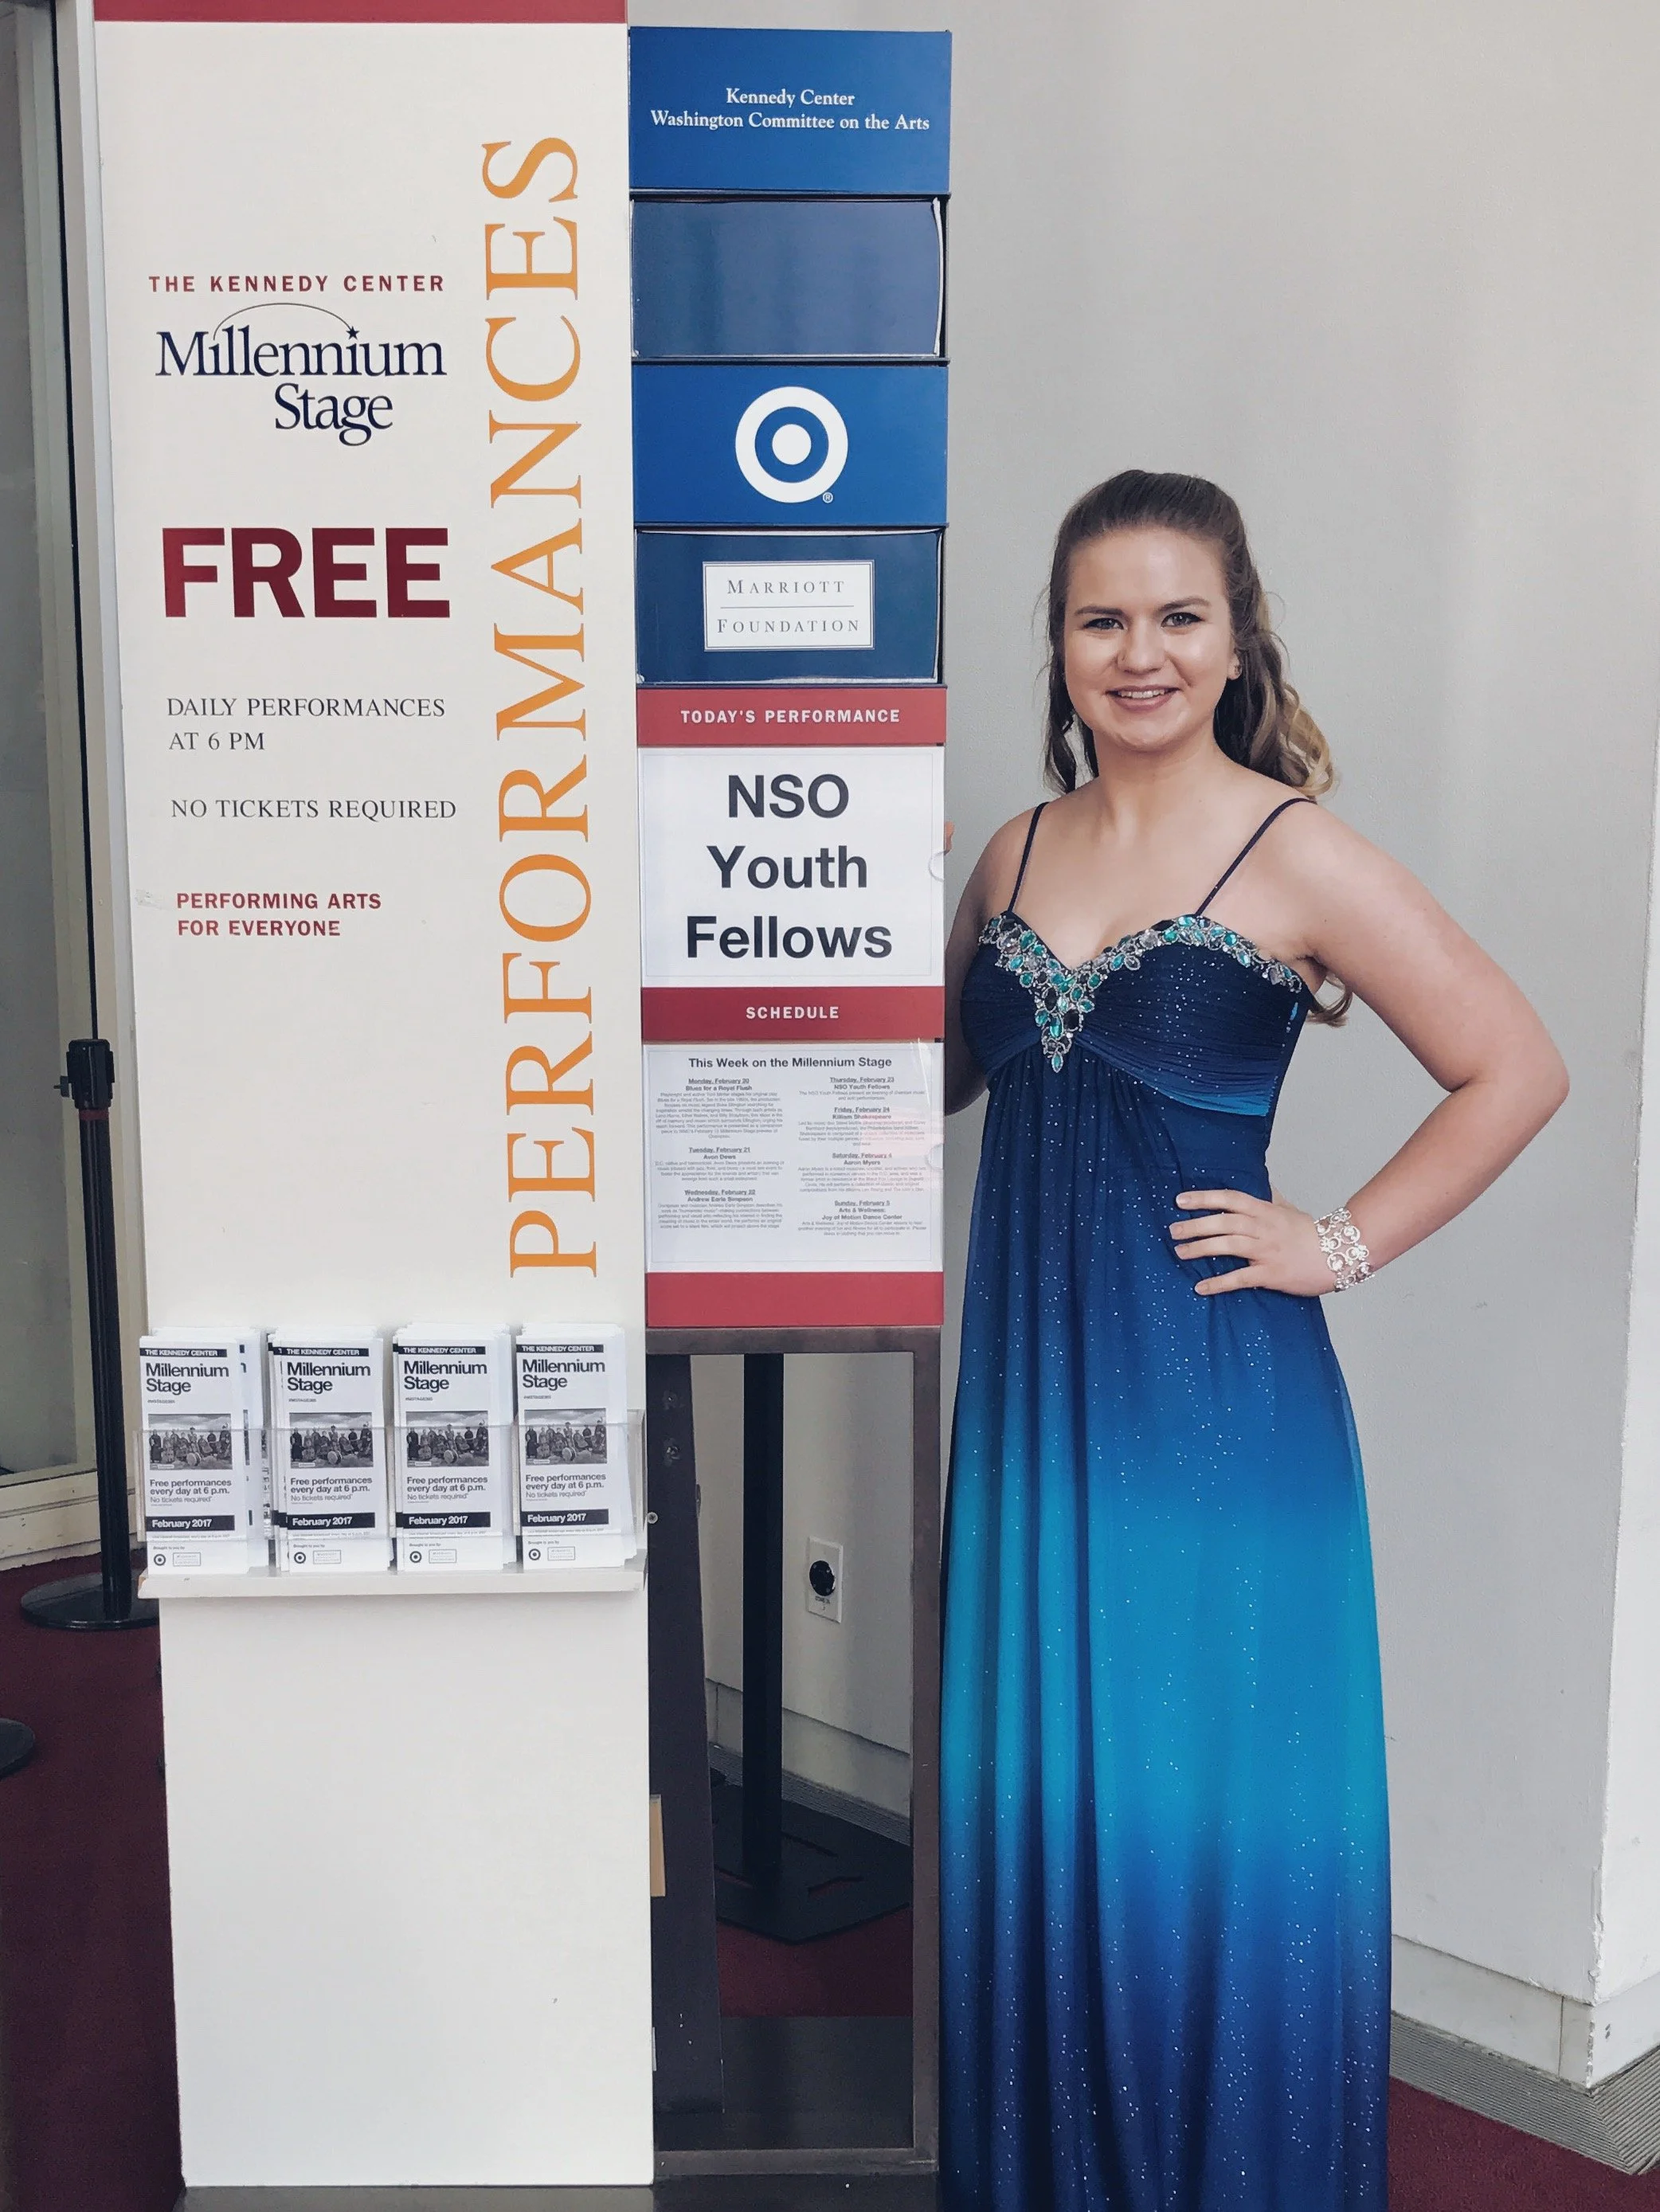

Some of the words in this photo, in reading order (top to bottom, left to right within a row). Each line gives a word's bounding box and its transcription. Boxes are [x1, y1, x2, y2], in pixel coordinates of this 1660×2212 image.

[726, 87, 797, 108] Kennedy
[800, 88, 855, 106] Center
[650, 109, 744, 131] Washington
[748, 112, 836, 129] Committee
[840, 118, 859, 129] on
[864, 112, 890, 130] the
[894, 113, 930, 131] Arts
[148, 276, 195, 292] THE
[210, 275, 328, 292] KENNEDY
[343, 275, 444, 292] CENTER
[155, 323, 448, 377] Millennium
[274, 382, 393, 447] Stage
[162, 527, 451, 618] FREE
[727, 579, 844, 594] MARRIOTT
[717, 618, 859, 633] FOUNDATION
[167, 698, 237, 716] DAILY
[247, 698, 445, 717] PERFORMANCES
[481, 136, 598, 1277] PERFORMANCES
[680, 710, 756, 723] TODAY'S
[765, 709, 900, 723] PERFORMANCE
[169, 732, 199, 750] AT
[208, 733, 220, 750] 6
[229, 732, 264, 750] PM
[728, 773, 849, 819] NSO
[171, 799, 207, 817] NO
[215, 799, 319, 818] TICKETS
[329, 800, 456, 822] REQUIRED
[706, 845, 867, 890] Youth
[177, 892, 318, 910] PERFORMING
[327, 893, 382, 910] ARTS
[178, 919, 219, 936] FOR
[229, 920, 341, 937] EVERYONE
[687, 915, 892, 959] Fellows
[746, 1006, 839, 1020] SCHEDULE
[688, 1058, 714, 1068] This
[715, 1057, 749, 1068] Week
[752, 1059, 767, 1068] on
[769, 1057, 789, 1067] the
[792, 1057, 855, 1067] Millennium
[858, 1056, 892, 1069] Stage
[146, 1362, 229, 1377] Millennium
[287, 1361, 370, 1376] Millennium
[404, 1360, 487, 1375] Millennium
[522, 1359, 605, 1373] Millennium
[146, 1379, 191, 1396] Stage
[287, 1377, 333, 1394] Stage
[404, 1376, 449, 1393] Stage
[522, 1374, 568, 1391] Stage
[171, 1479, 232, 1488] performances
[311, 1476, 373, 1487] performances
[428, 1476, 488, 1486] performances
[546, 1473, 606, 1483] performances
[290, 1486, 315, 1494] every
[316, 1485, 332, 1494] day
[407, 1485, 430, 1494] every
[432, 1484, 448, 1493] day
[525, 1482, 549, 1491] every
[550, 1482, 567, 1490] day
[585, 1482, 605, 1490] p.m.
[152, 1520, 190, 1529] February
[292, 1517, 331, 1527] February
[332, 1517, 352, 1525] 2017
[409, 1517, 447, 1525] February
[527, 1514, 566, 1523] February
[567, 1513, 587, 1522] 2017
